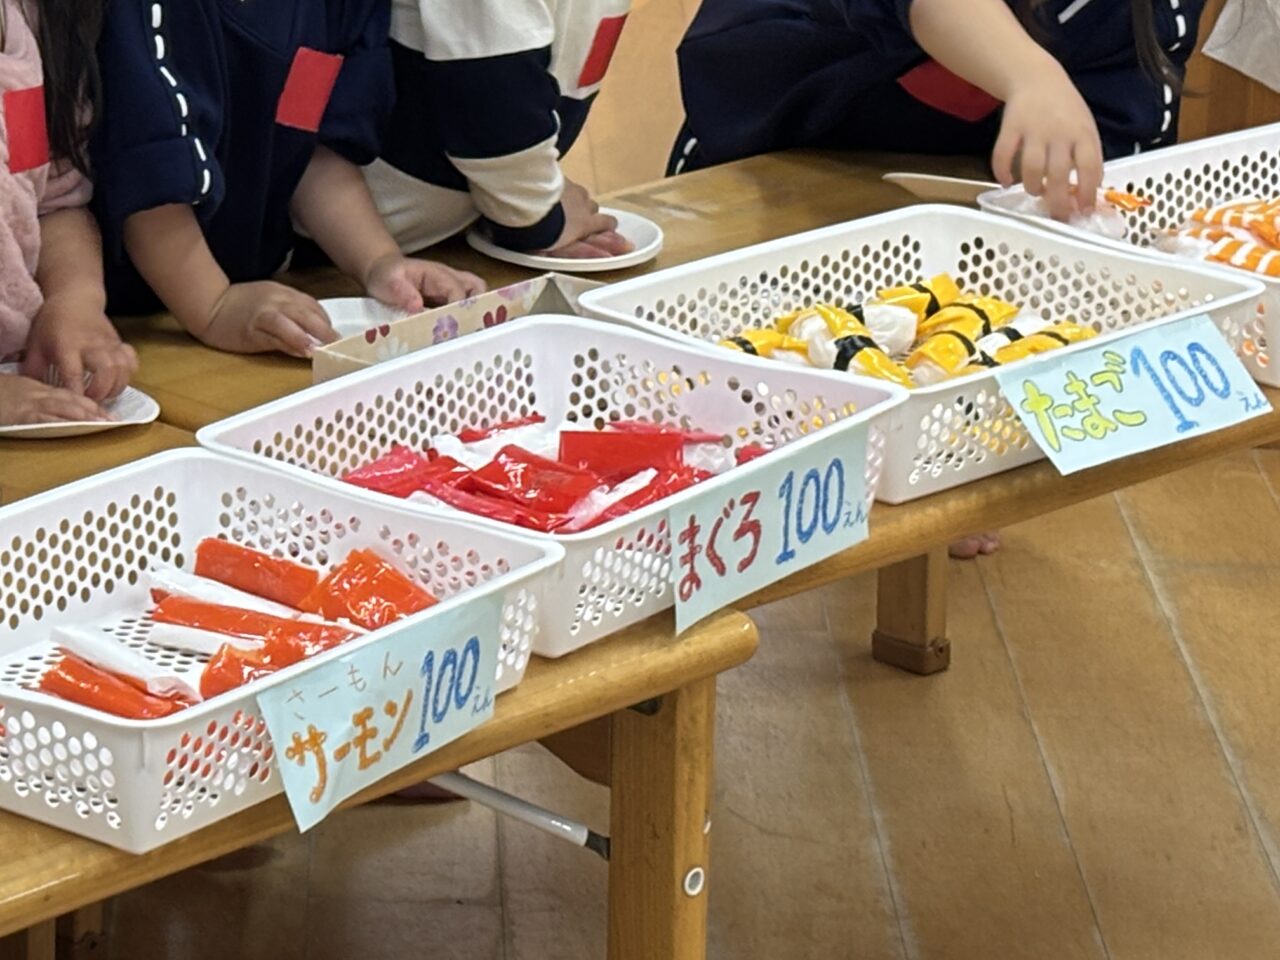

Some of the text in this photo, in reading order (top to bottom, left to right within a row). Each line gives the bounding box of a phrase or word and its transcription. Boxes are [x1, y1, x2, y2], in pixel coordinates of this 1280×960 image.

[678, 490, 763, 602] まぐろ
[284, 688, 414, 804] サーモン
